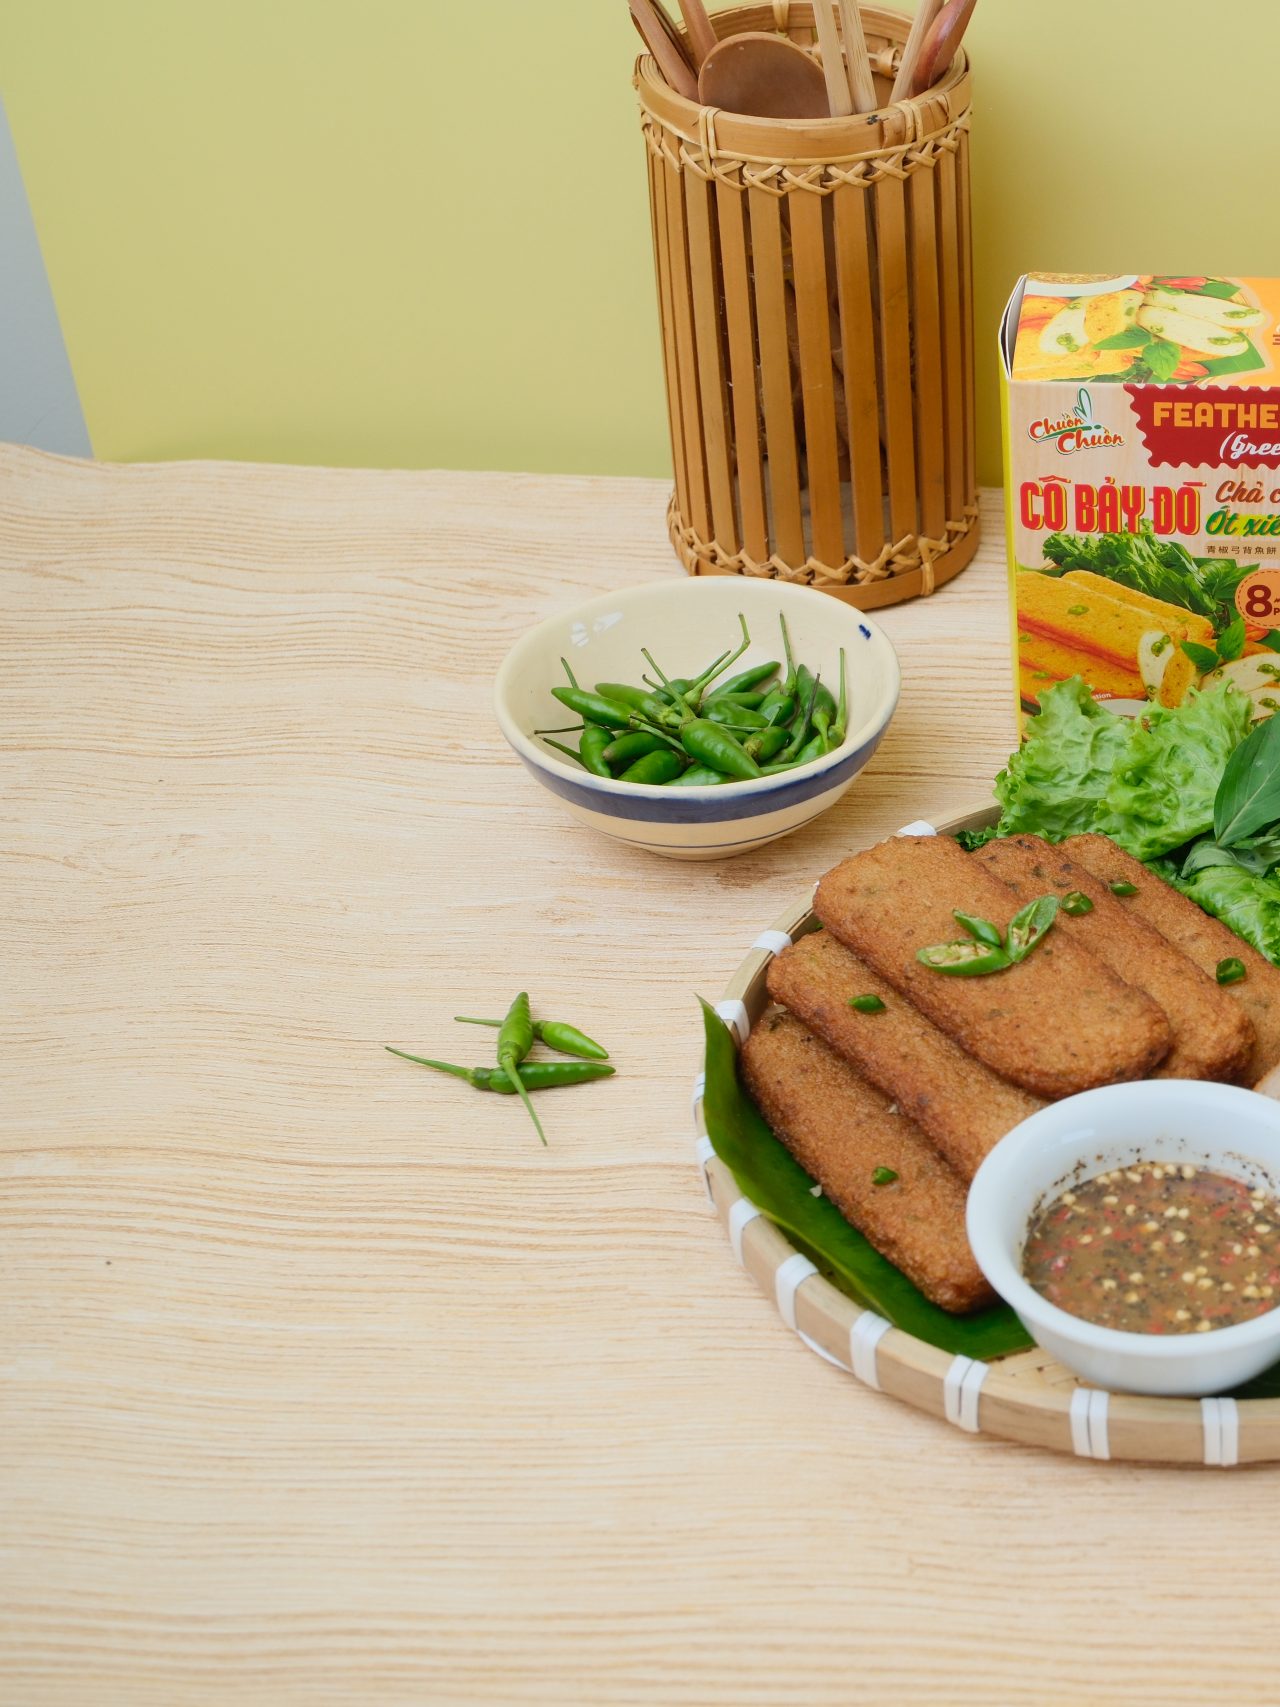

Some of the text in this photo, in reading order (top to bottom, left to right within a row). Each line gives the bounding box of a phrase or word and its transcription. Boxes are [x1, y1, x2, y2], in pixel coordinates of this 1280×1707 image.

[1020, 475, 1071, 531] CÔ
[1075, 477, 1145, 534] BẢY
[1215, 480, 1265, 503] Chả
[1245, 584, 1273, 617] 8
